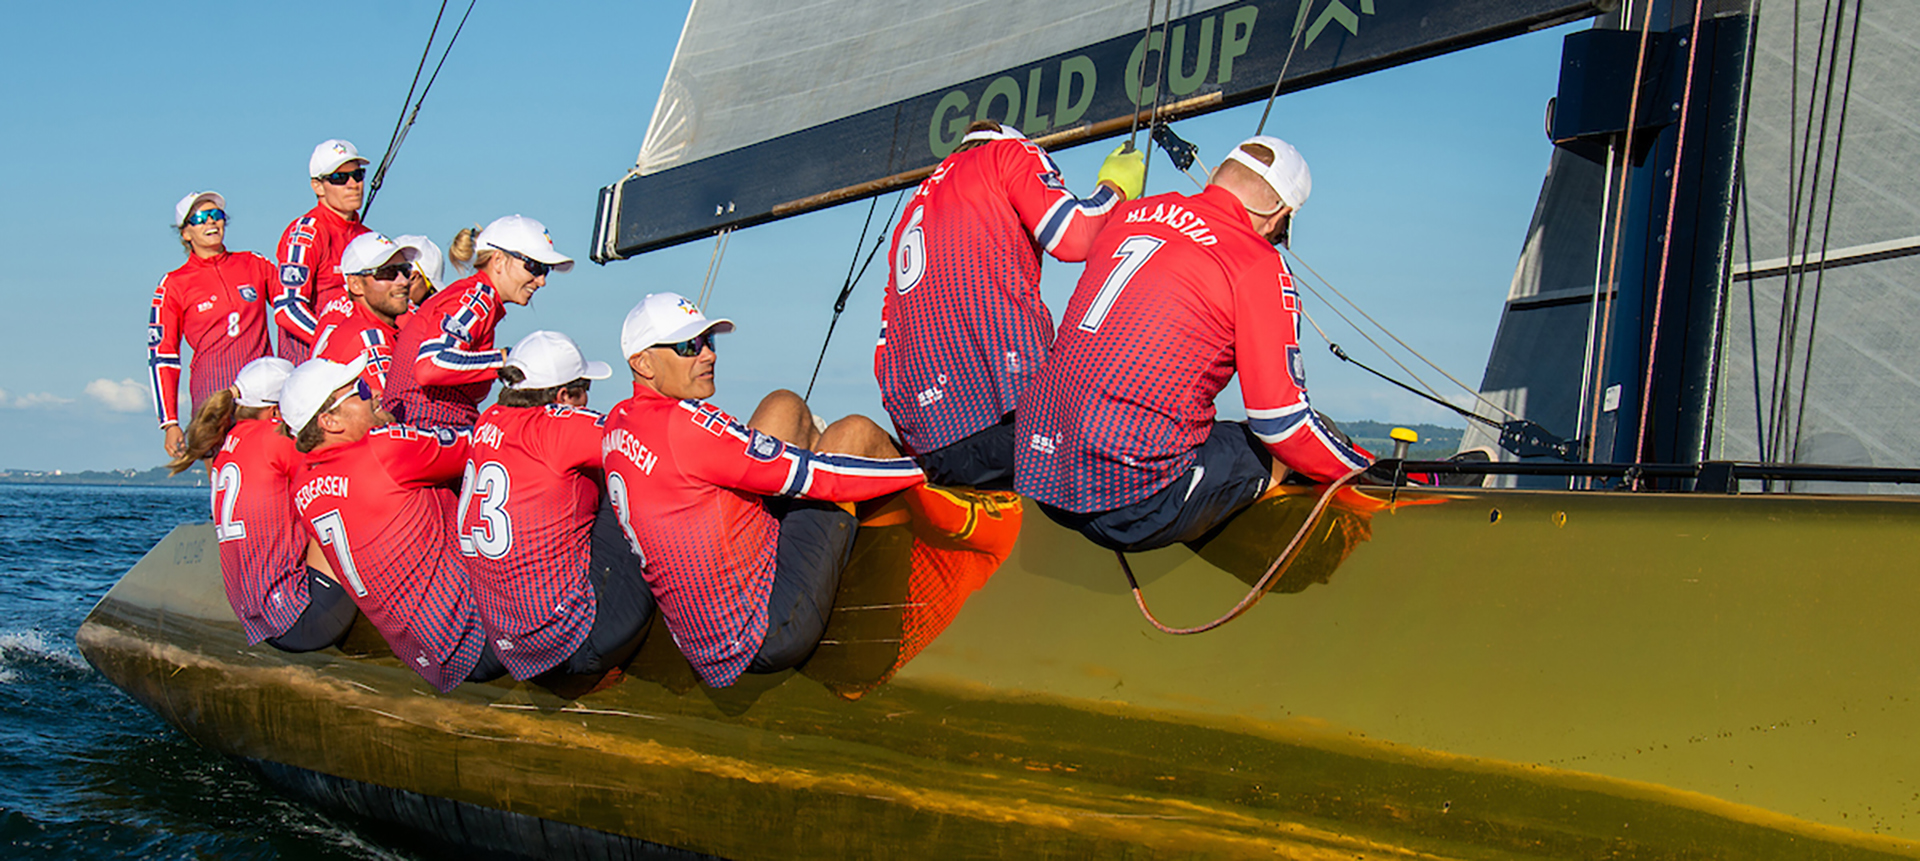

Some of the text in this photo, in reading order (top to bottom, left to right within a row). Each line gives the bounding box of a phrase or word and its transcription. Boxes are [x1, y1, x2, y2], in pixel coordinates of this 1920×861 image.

[929, 5, 1259, 159] GOLD CUP
[895, 204, 927, 296] 6
[1078, 234, 1168, 339] 1
[227, 311, 240, 337] 8
[311, 508, 368, 598] 7
[457, 458, 513, 560] 23
